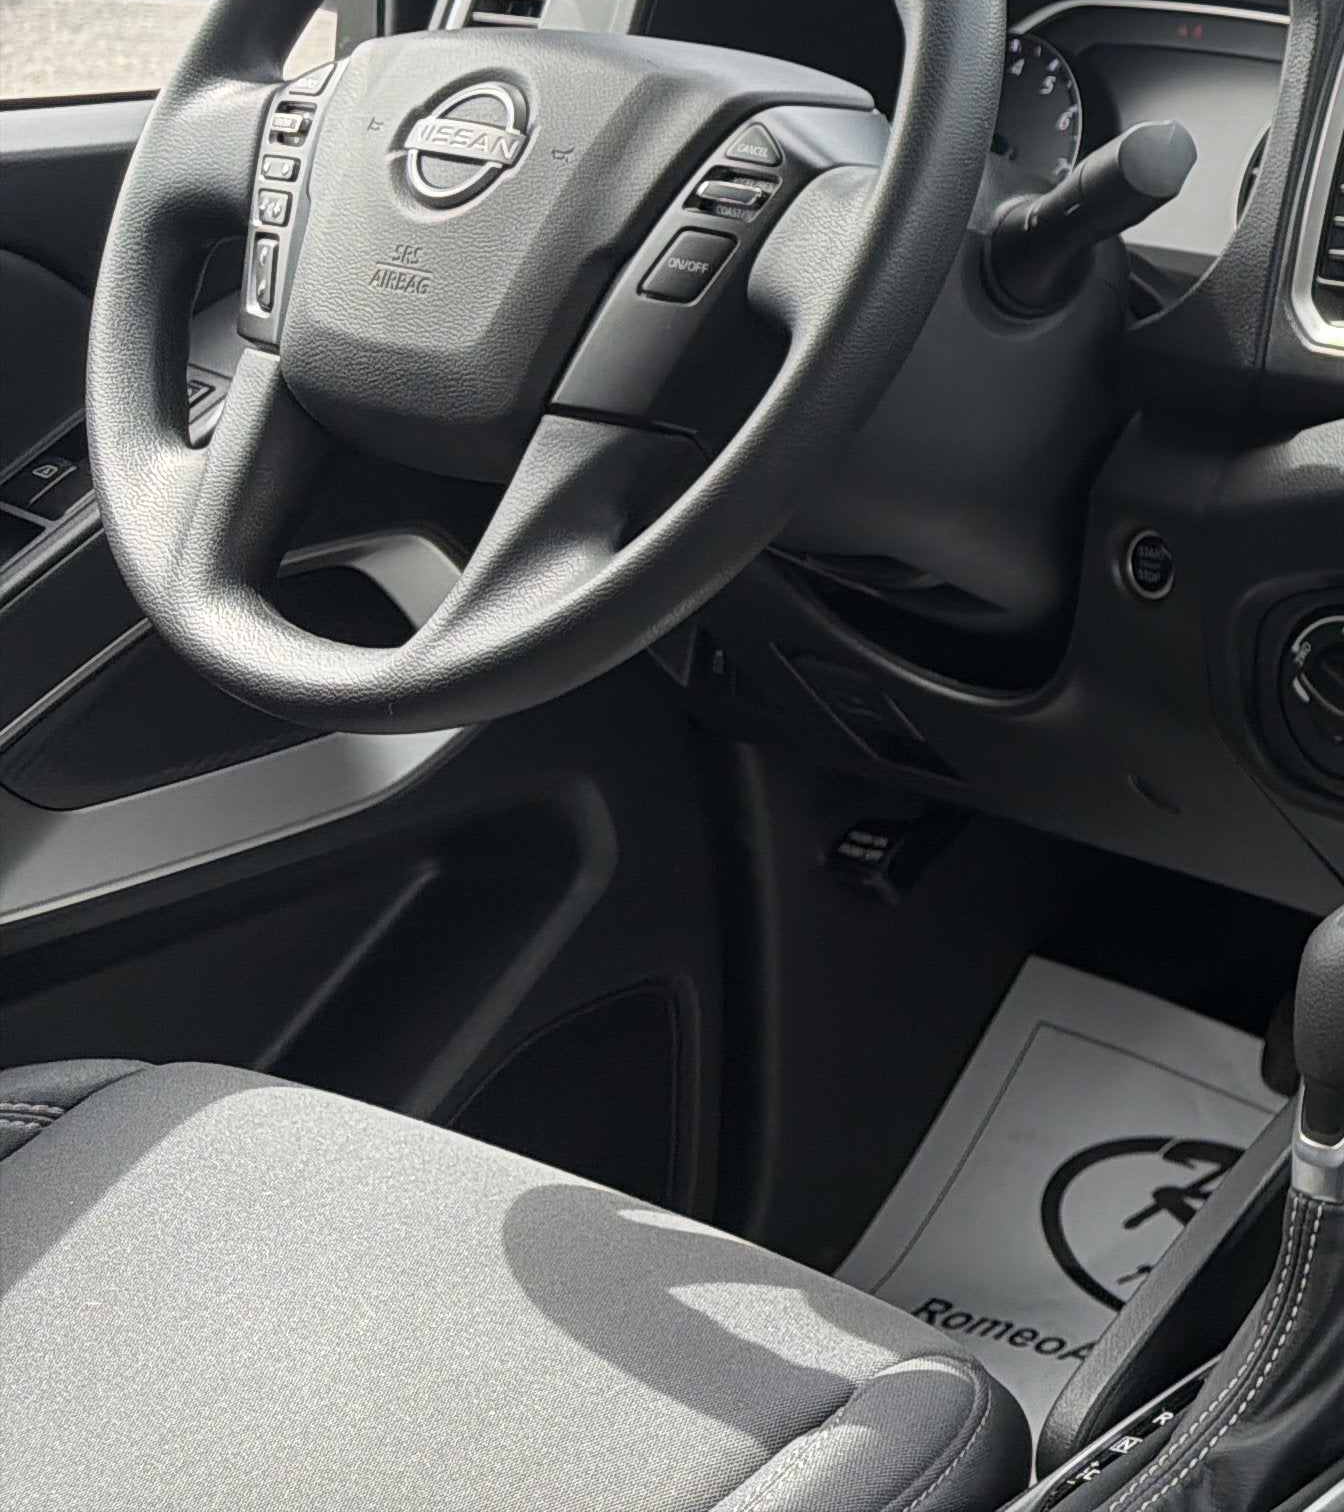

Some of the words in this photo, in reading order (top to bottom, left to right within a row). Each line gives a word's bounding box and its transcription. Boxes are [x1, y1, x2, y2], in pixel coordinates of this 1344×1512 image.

[1039, 75, 1057, 96] 5
[1056, 110, 1074, 131] 6
[413, 122, 522, 161] NISSAN
[737, 143, 768, 158] CANCEL
[392, 243, 424, 265] SRS
[668, 256, 710, 274] ON/OFF
[368, 271, 434, 296] AIRBAG
[910, 1296, 1098, 1362] RomeoA
[1152, 1409, 1175, 1426] R
